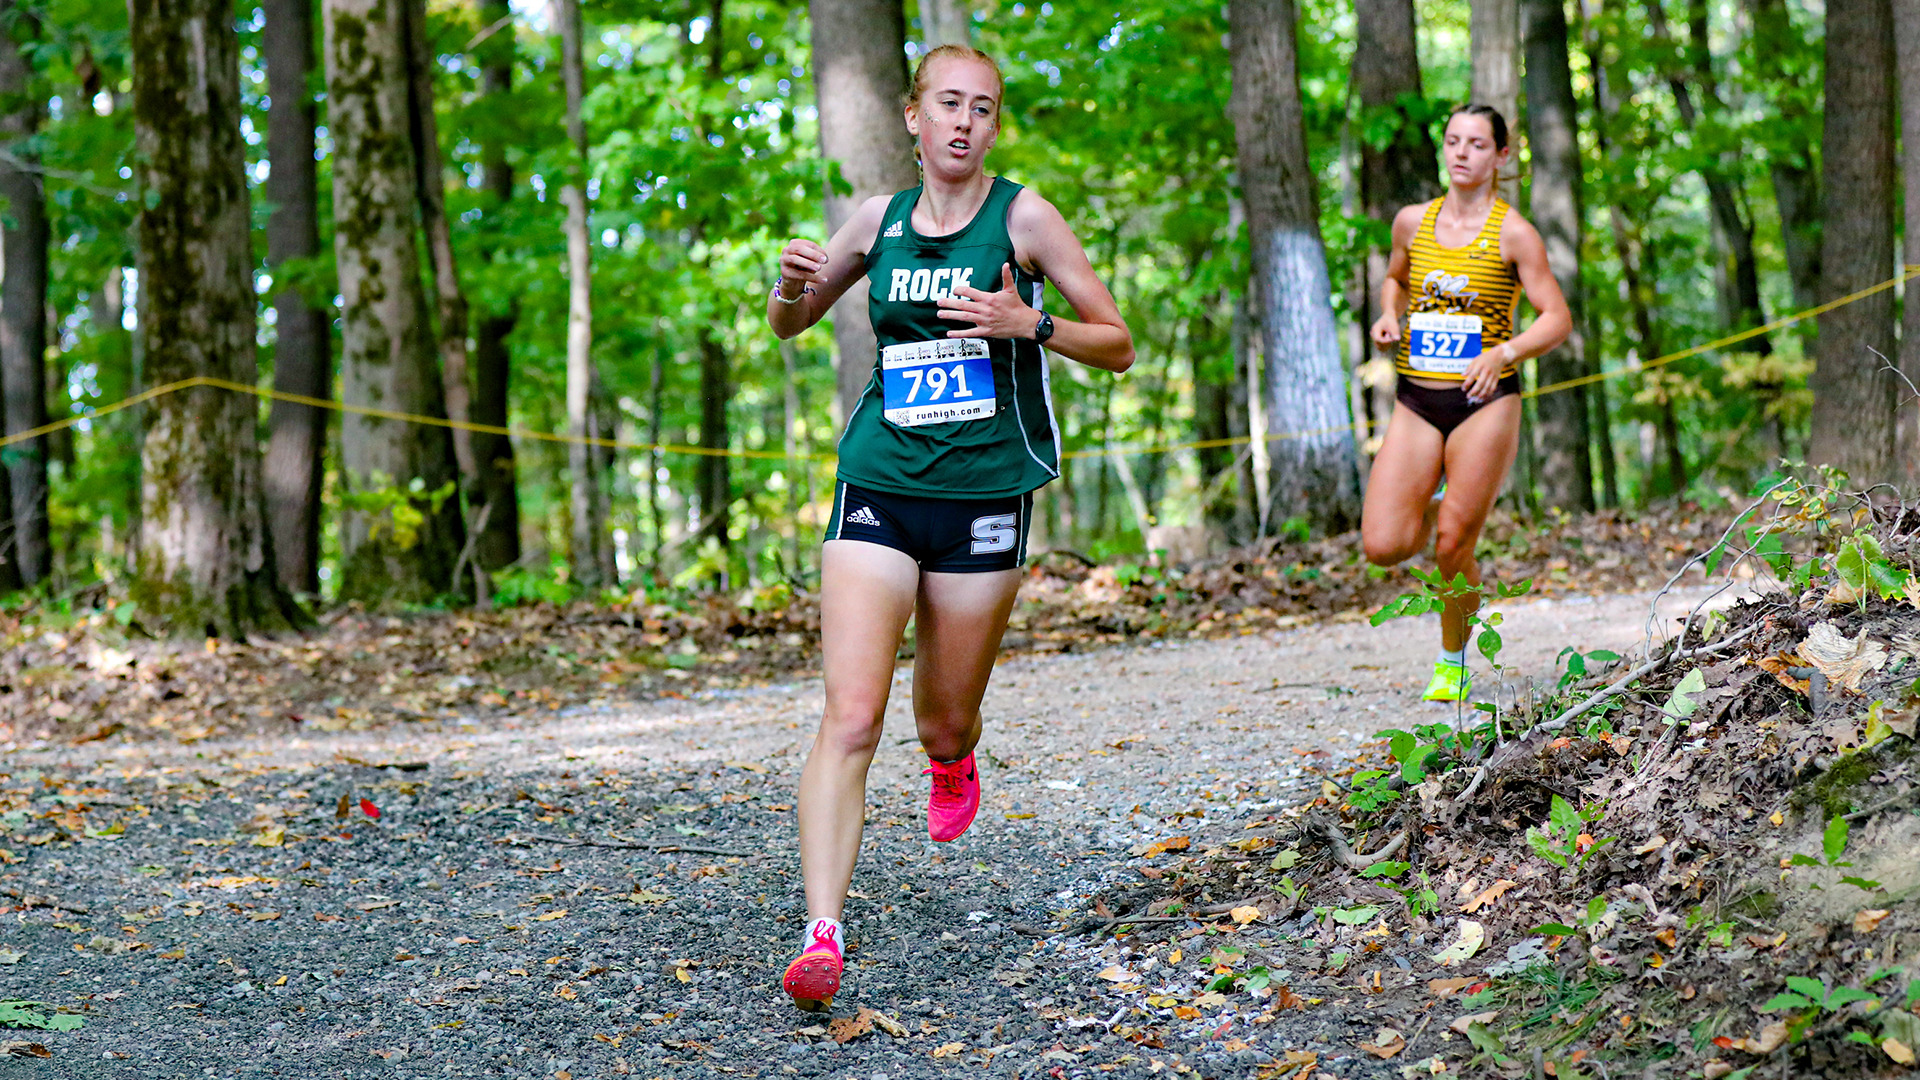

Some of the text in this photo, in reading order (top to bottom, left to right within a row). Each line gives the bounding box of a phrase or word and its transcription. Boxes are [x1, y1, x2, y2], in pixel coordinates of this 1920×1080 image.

[888, 267, 974, 302] ROCK
[1421, 331, 1468, 357] 527
[902, 364, 973, 403] 791
[916, 406, 981, 419] runhigh.com
[846, 515, 881, 527] adidas
[970, 512, 1017, 555] S
